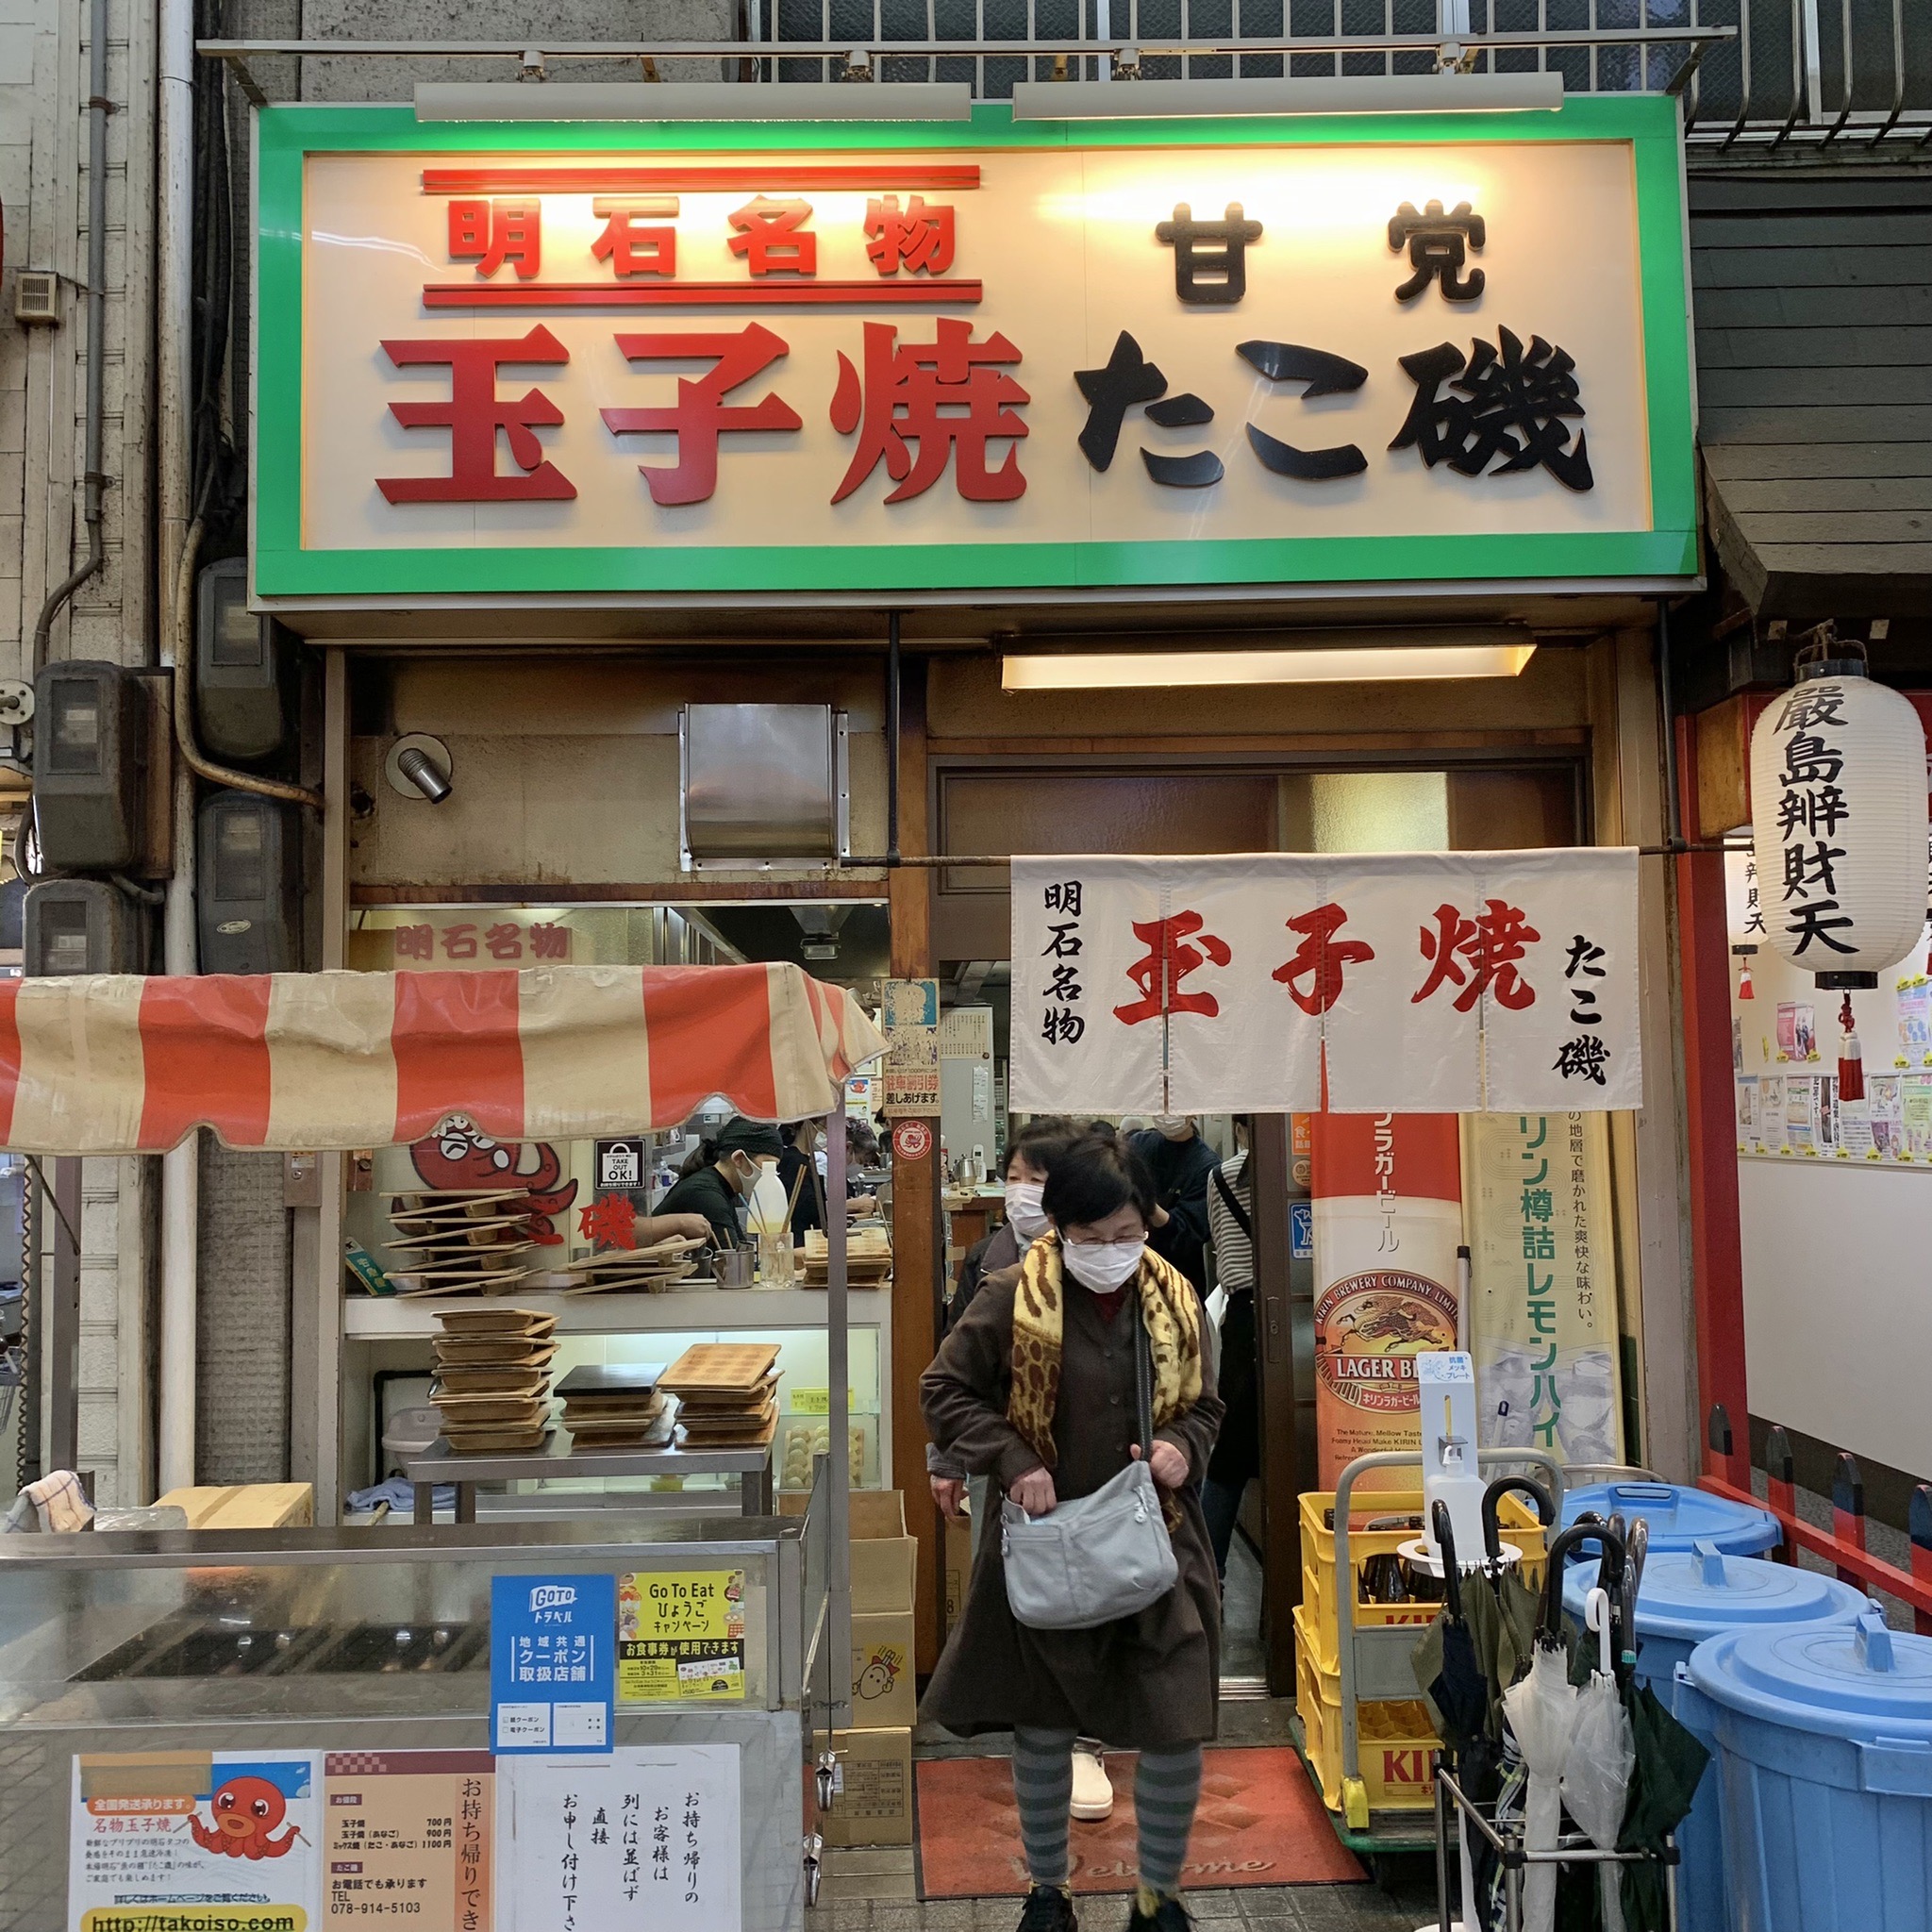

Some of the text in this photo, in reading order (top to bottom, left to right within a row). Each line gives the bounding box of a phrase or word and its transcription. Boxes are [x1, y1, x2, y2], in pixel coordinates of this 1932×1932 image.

[448, 194, 956, 278] 明石名物
[1157, 200, 1488, 307] 甘党
[375, 320, 1030, 508] 玉子焼
[1073, 325, 1594, 494] たこ磯
[395, 922, 568, 959] 明石名物
[1041, 879, 1085, 1046] 明石名物
[1112, 898, 1542, 1026] 玉子焼
[1552, 934, 1612, 1087] たこ磯
[886, 1075, 939, 1091] 駐車割引券
[886, 1091, 940, 1105] 差しあげます。
[608, 1170, 632, 1180] OK!
[1315, 1297, 1334, 1324] KIRIN
[1333, 1274, 1378, 1301] BREWERY
[1336, 1358, 1396, 1378] LAGER
[649, 1583, 714, 1598] Go To Eat
[534, 1610, 573, 1624] トラベル
[658, 1599, 708, 1618] ひょうご
[654, 1620, 708, 1633] キャンペーン
[519, 1635, 587, 1647] 地域共通
[625, 1641, 739, 1657] お食事券が使用できます
[519, 1648, 587, 1664] クーポン
[519, 1666, 586, 1682] 取扱店舗
[1382, 1750, 1434, 1783] KI
[93, 1798, 191, 1811] 全国発送承ります。
[93, 1817, 173, 1833] 名物玉子焼
[341, 1817, 452, 1828] 玉子焼 700円
[591, 1807, 610, 1845] 直接
[426, 1828, 452, 1838] 900円
[422, 1840, 452, 1849] 1100円
[621, 1793, 640, 1902] 列には並ばず
[652, 1807, 670, 1881] お客様は
[682, 1791, 701, 1904] お持ち帰りの
[460, 1778, 482, 1931] お持ち帰りでき
[561, 1793, 580, 1931] お申し付け下さ
[332, 1878, 427, 1890] お電話でも承ります
[331, 1890, 350, 1902] TEL
[331, 1902, 421, 1914] 078-914-5103
[92, 1915, 294, 1932] http://takoiso.com
